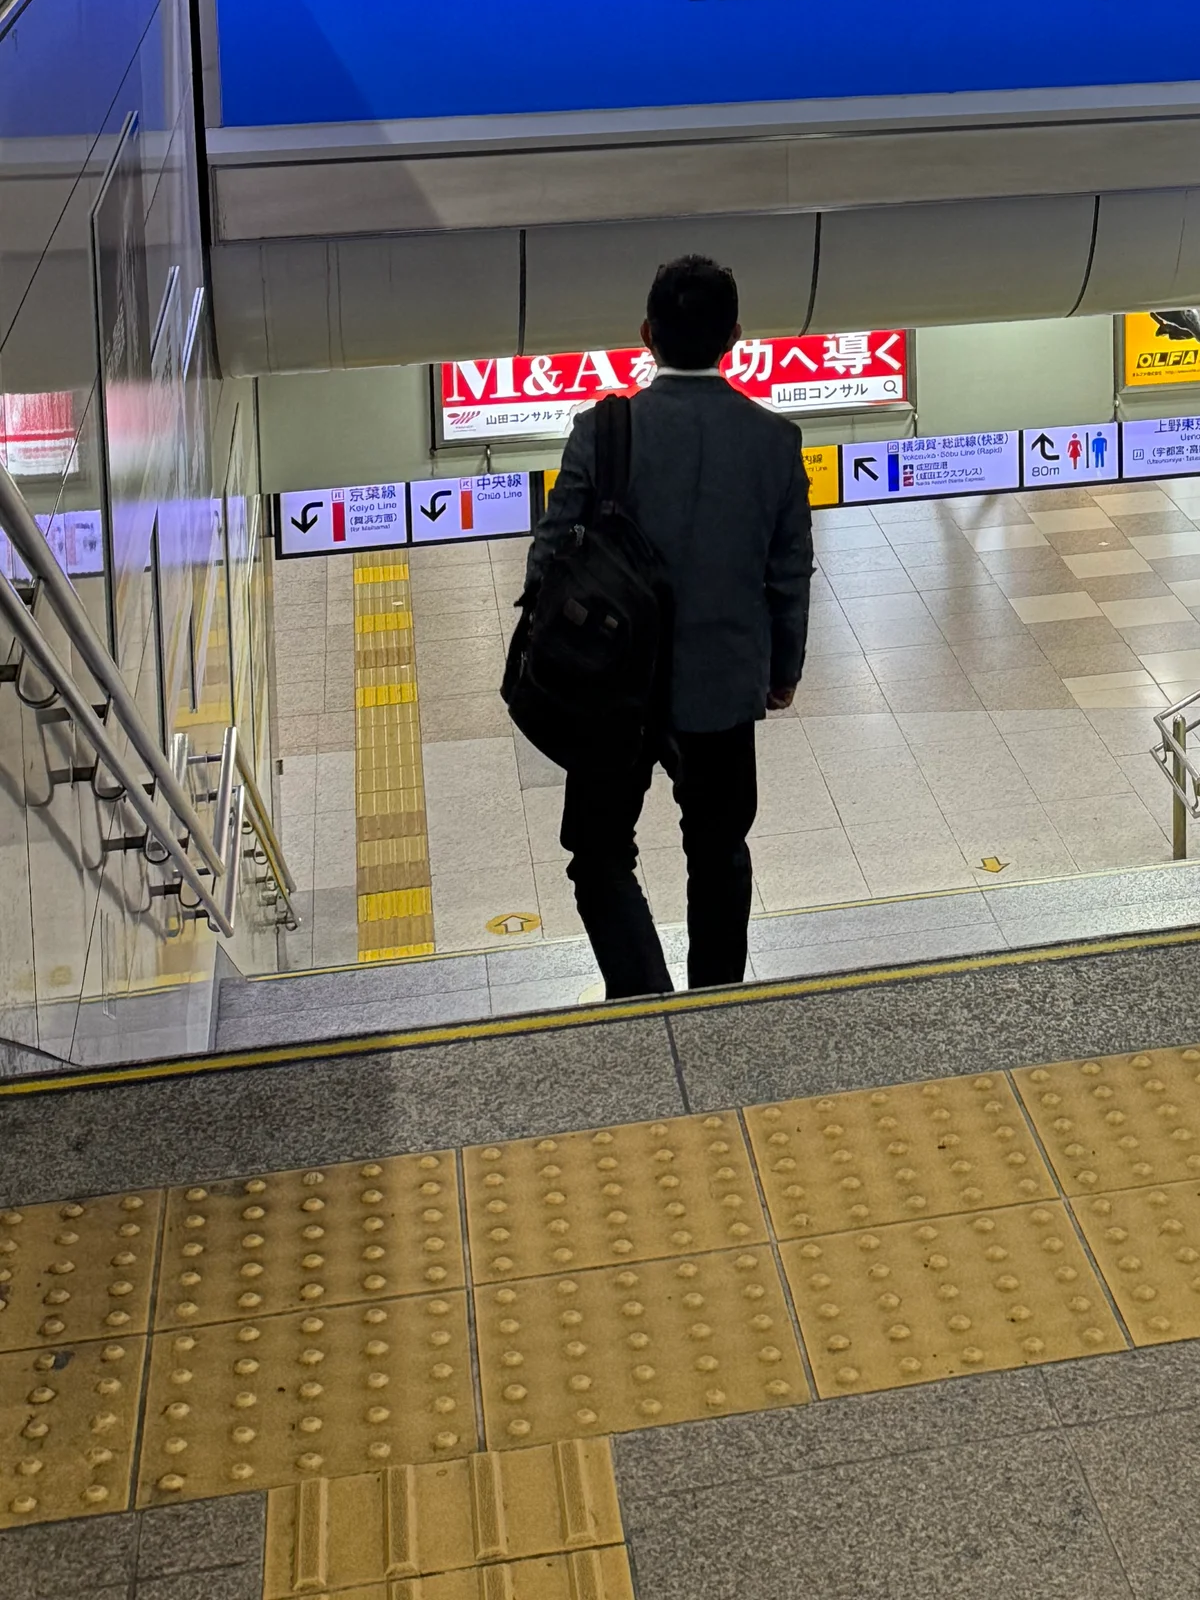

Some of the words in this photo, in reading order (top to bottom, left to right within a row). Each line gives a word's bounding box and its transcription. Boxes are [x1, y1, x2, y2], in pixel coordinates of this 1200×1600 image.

[1136, 350, 1199, 369] OLFA
[777, 382, 869, 403] 山田コンサル
[1031, 466, 1060, 477] 80m
[476, 473, 522, 491] 中央線
[348, 485, 396, 502] 京葉線
[503, 491, 522, 499] Line
[377, 502, 397, 510] Line
